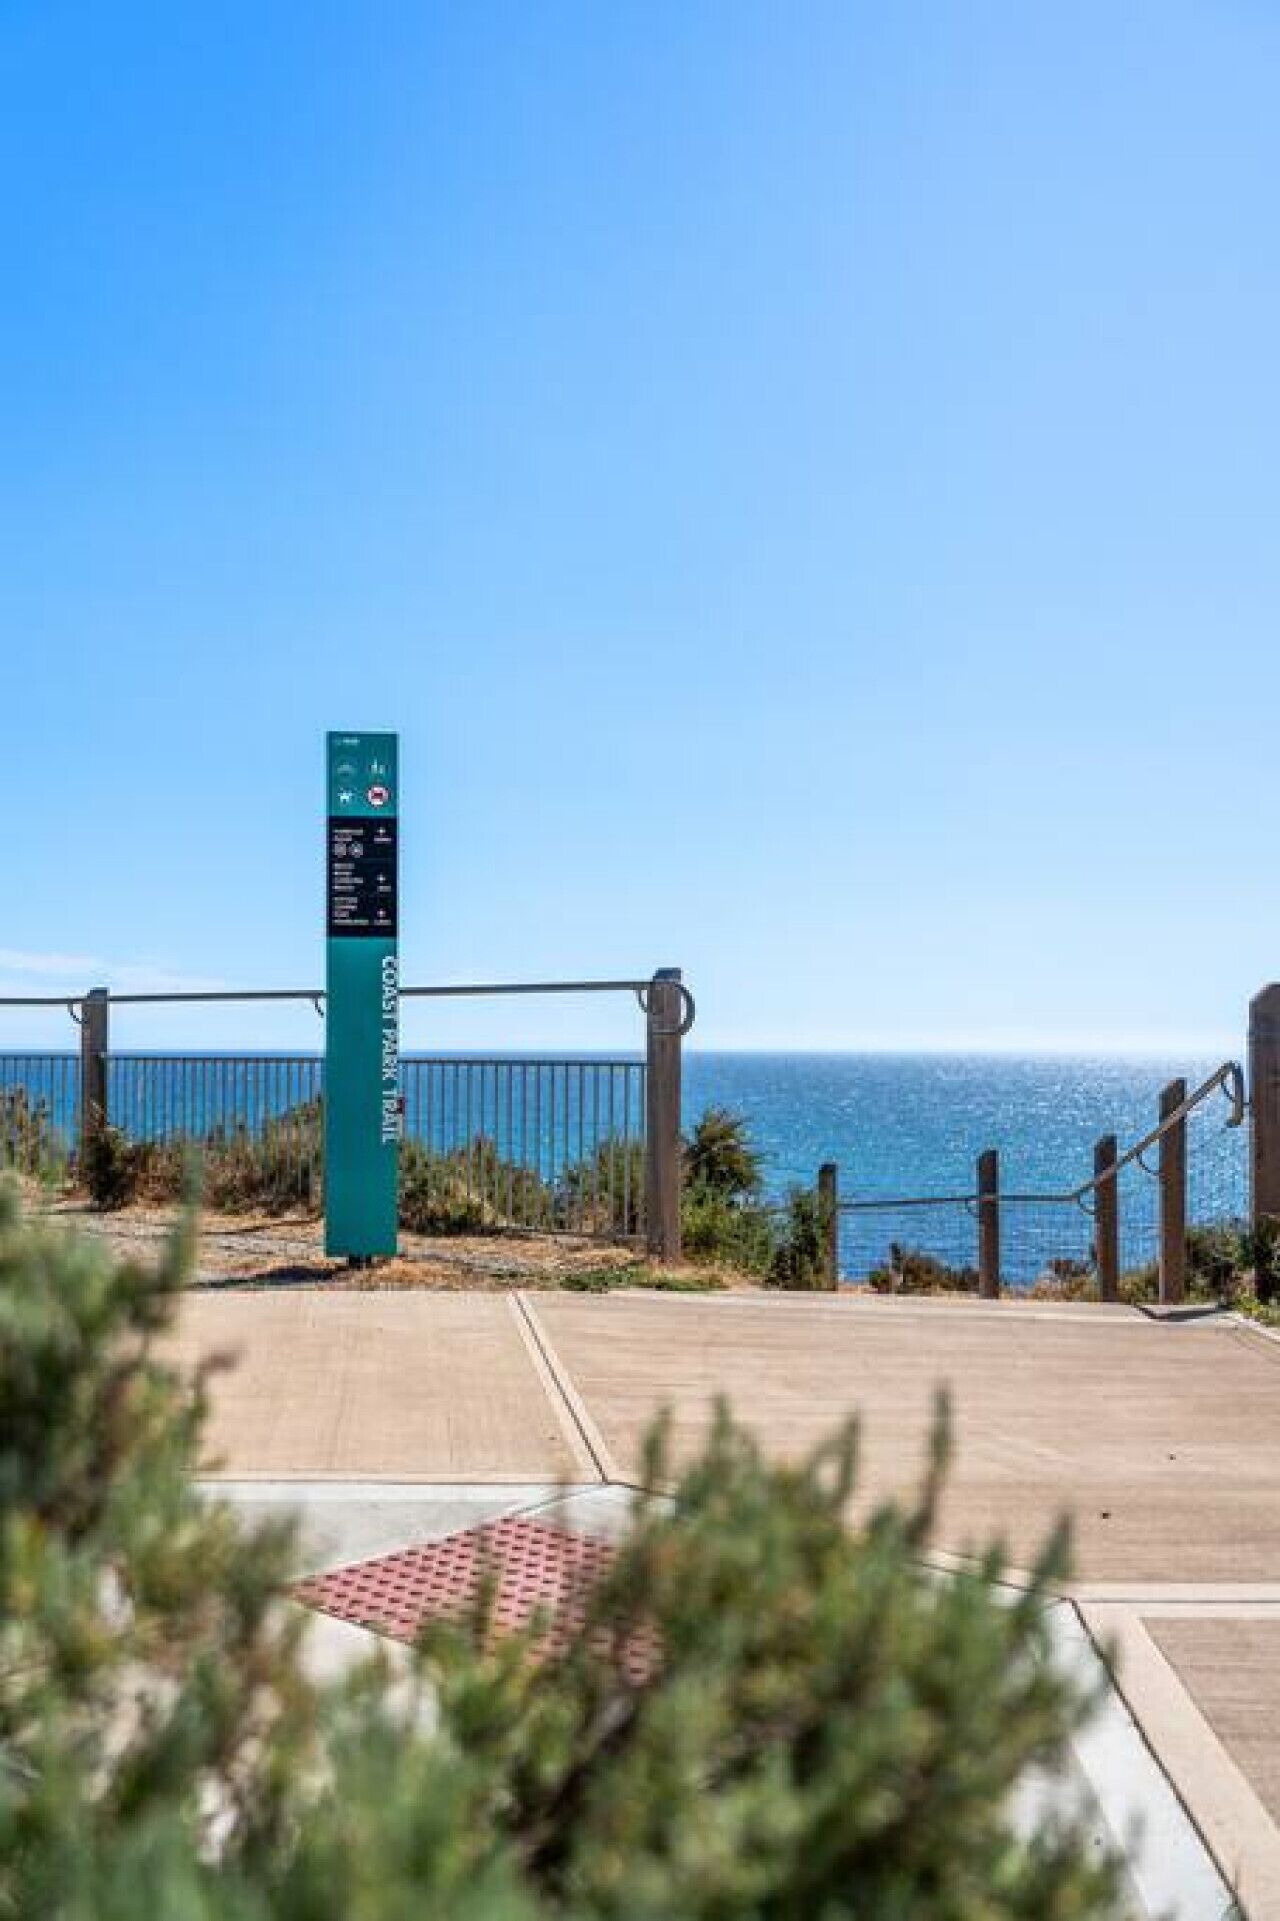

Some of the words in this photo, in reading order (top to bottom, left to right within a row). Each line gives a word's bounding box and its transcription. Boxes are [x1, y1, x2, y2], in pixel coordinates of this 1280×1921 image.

[381, 955, 399, 1019] COAST
[381, 1028, 399, 1081] PARK
[381, 1090, 399, 1145] TRAIL
